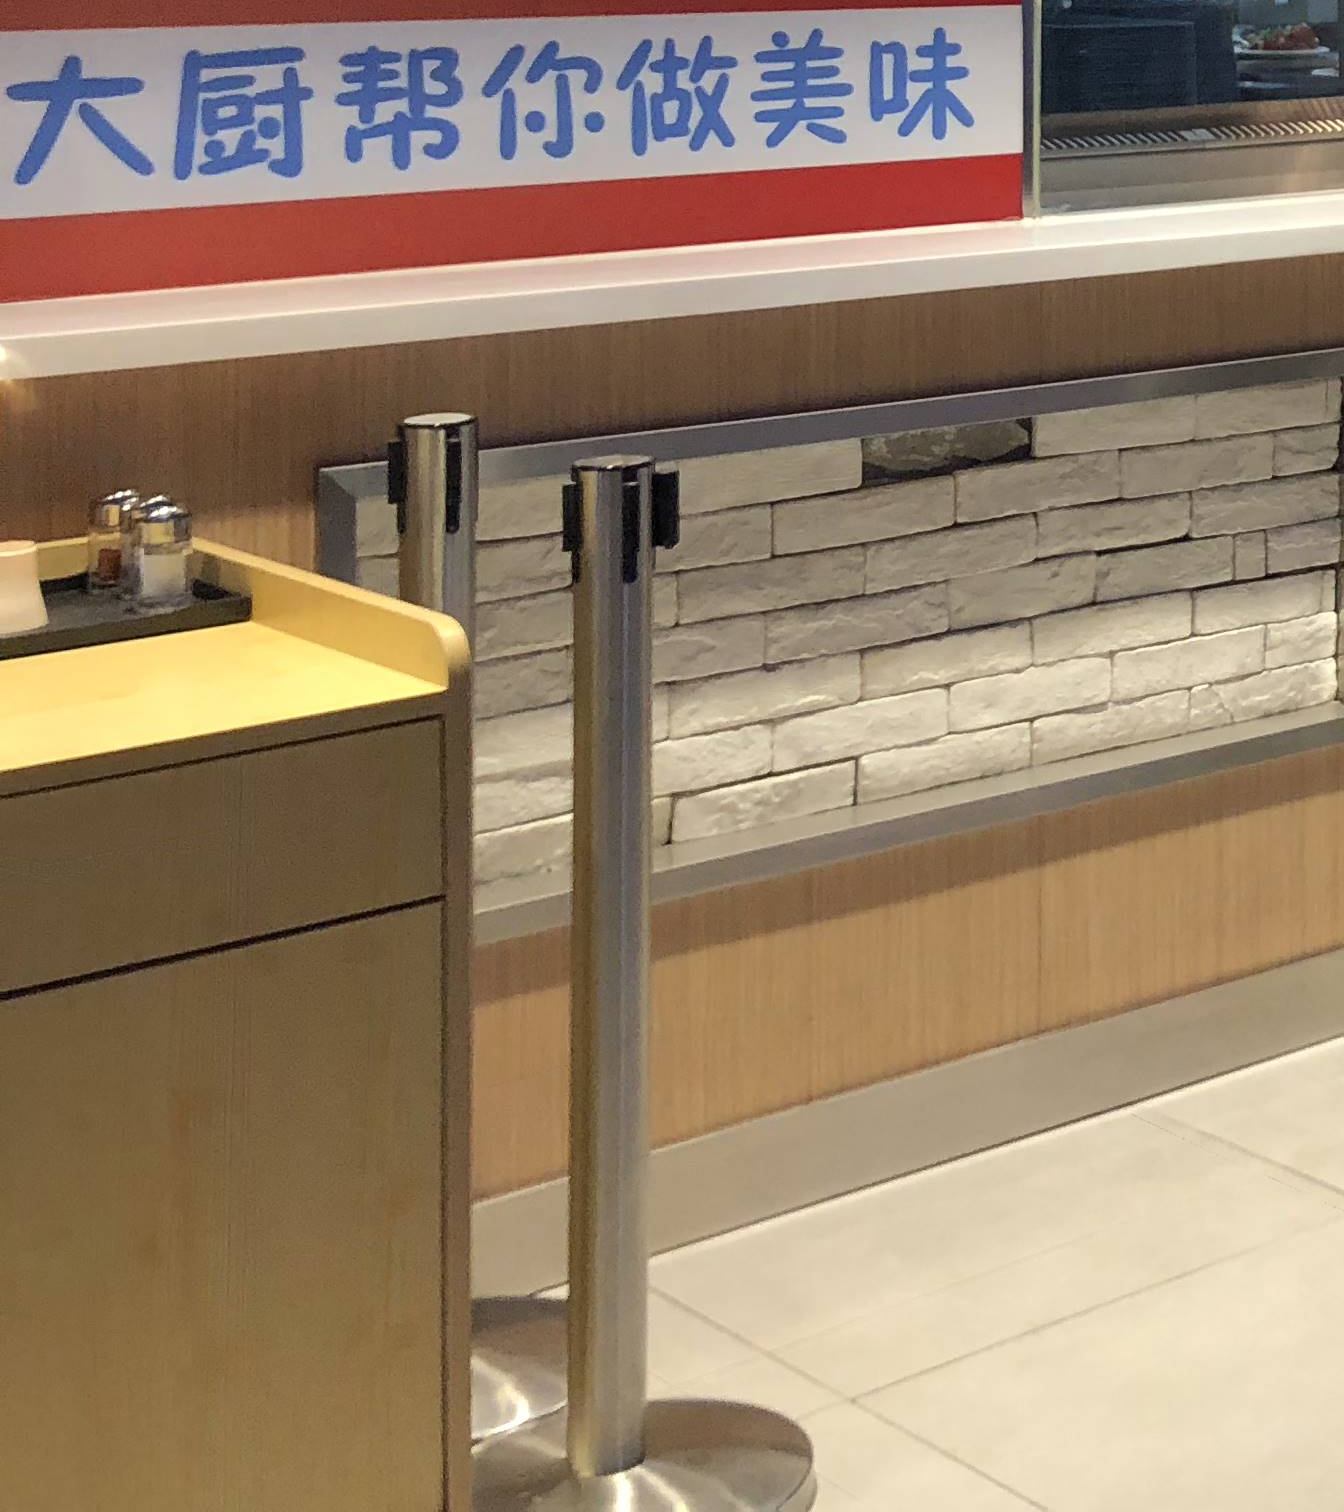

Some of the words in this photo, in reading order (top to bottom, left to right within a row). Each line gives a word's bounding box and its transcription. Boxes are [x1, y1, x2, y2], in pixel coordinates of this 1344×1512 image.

[5, 26, 975, 186] 大厨帮你做美味
